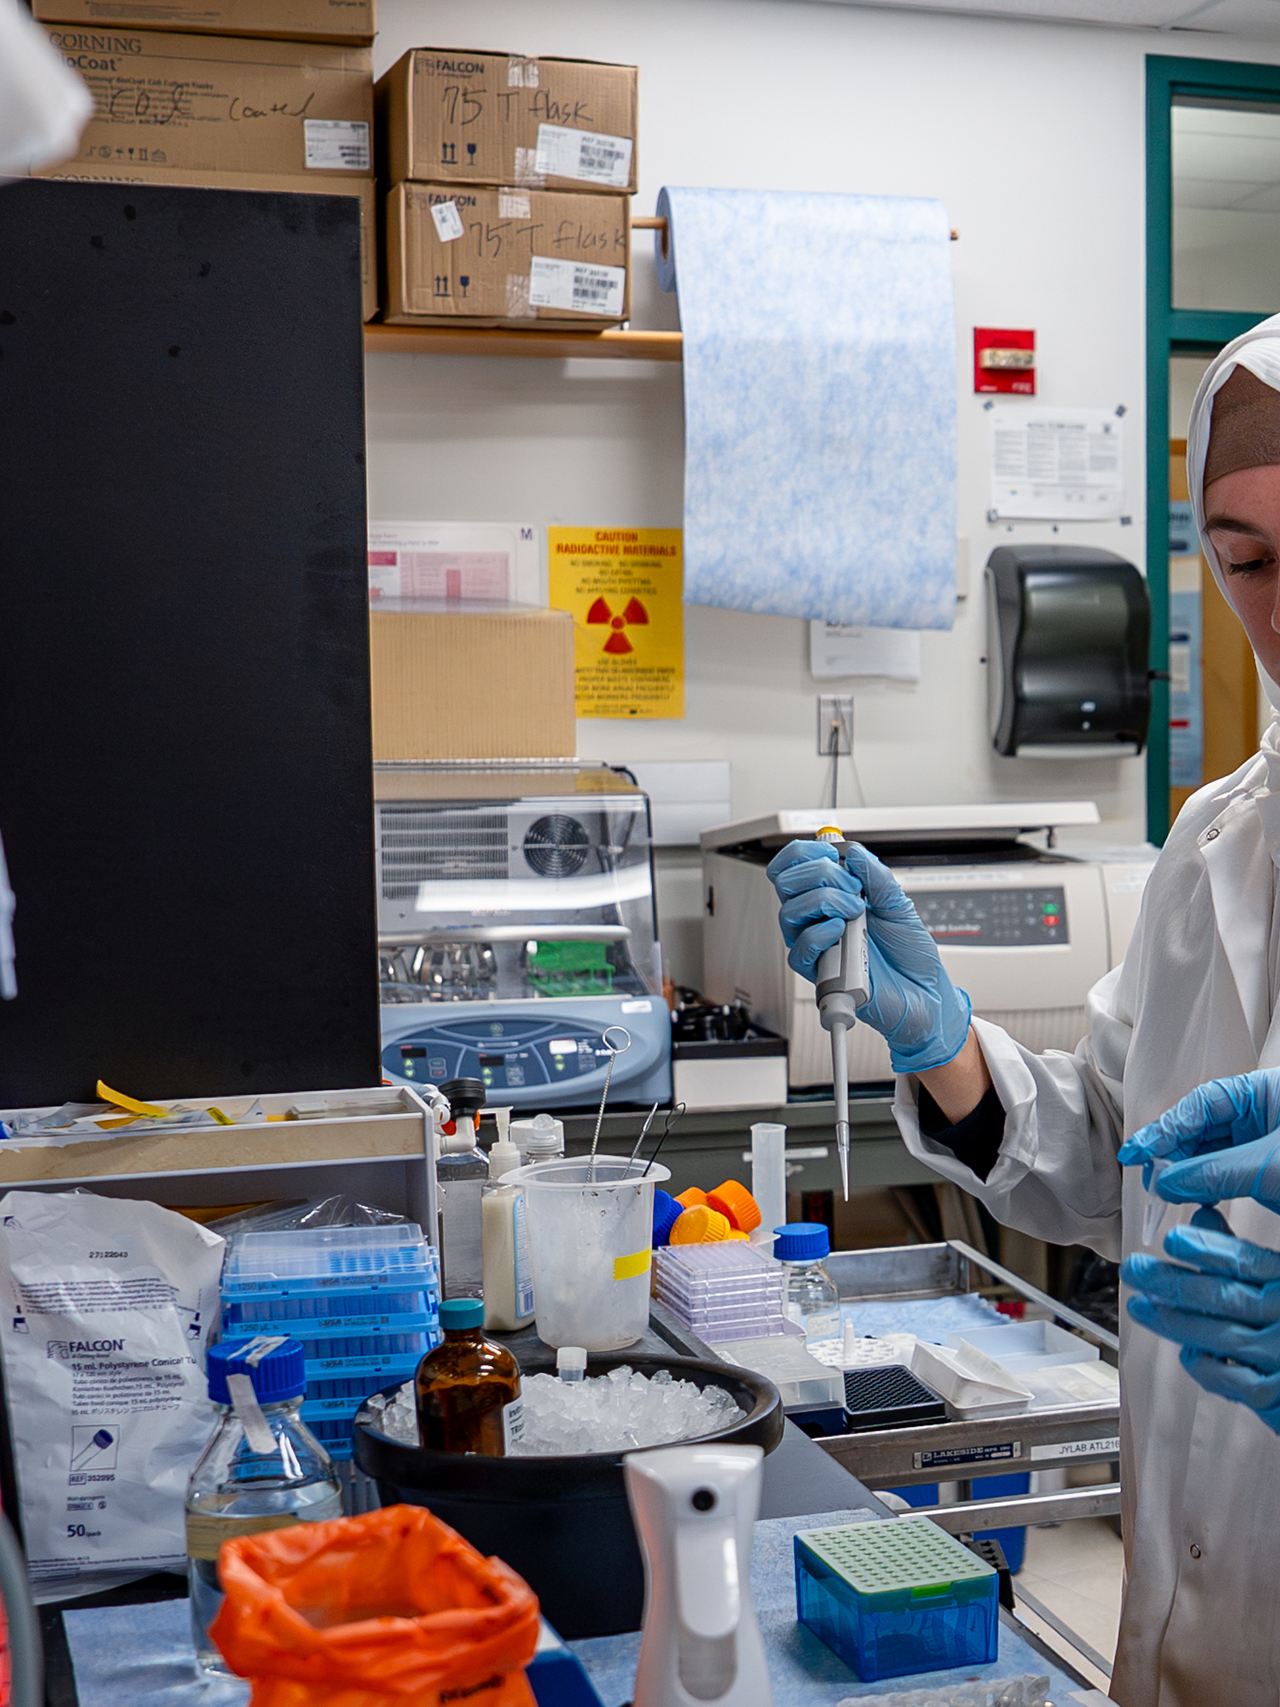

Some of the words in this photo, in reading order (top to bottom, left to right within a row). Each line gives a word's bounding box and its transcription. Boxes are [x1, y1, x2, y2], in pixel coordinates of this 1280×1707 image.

[50, 32, 142, 54] CORNING
[436, 60, 484, 74] FALCON
[442, 86, 487, 126] 75
[497, 92, 520, 123] T
[528, 90, 594, 124] flask
[470, 221, 513, 258] 75
[517, 224, 544, 255] T
[553, 220, 626, 250] flask
[595, 531, 639, 543] CAUTION
[556, 543, 621, 555] RADIOACTIVE
[623, 544, 677, 557] MATERIALS
[69, 1339, 123, 1352] FALCON
[71, 1362, 82, 1371] 15
[99, 1361, 150, 1371] Polystyrene
[152, 1357, 184, 1367] Conical
[933, 1446, 985, 1459] LAKESIDE
[1059, 1443, 1088, 1455] JYLAB
[67, 1523, 86, 1538] 50
